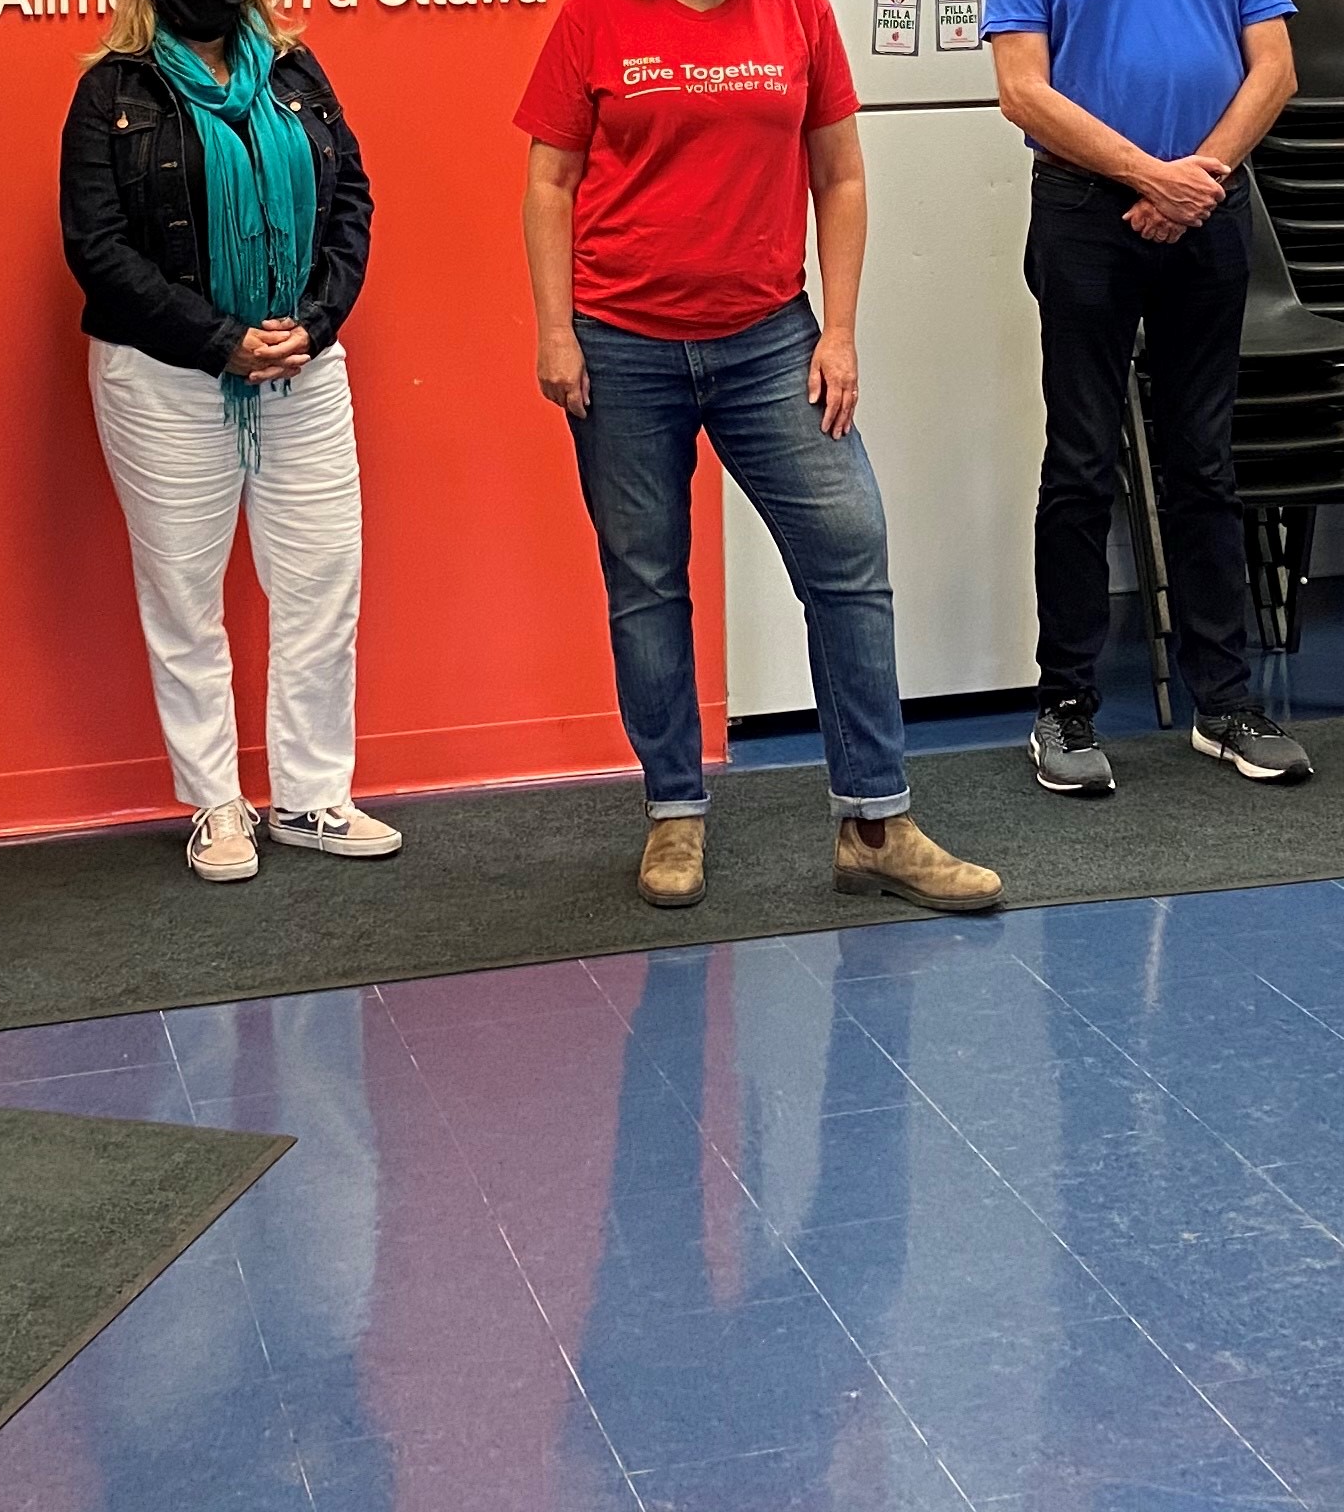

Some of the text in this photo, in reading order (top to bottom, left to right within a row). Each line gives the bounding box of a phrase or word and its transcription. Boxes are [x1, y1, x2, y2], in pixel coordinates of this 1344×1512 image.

[882, 9, 911, 19] FILL A
[944, 4, 973, 15] FILL A
[877, 19, 915, 30] FRIDGE!
[940, 14, 977, 25] FRIDGE!
[622, 56, 662, 67] ROGERS
[623, 60, 785, 85] Give Together
[685, 78, 788, 95] volunteer day
